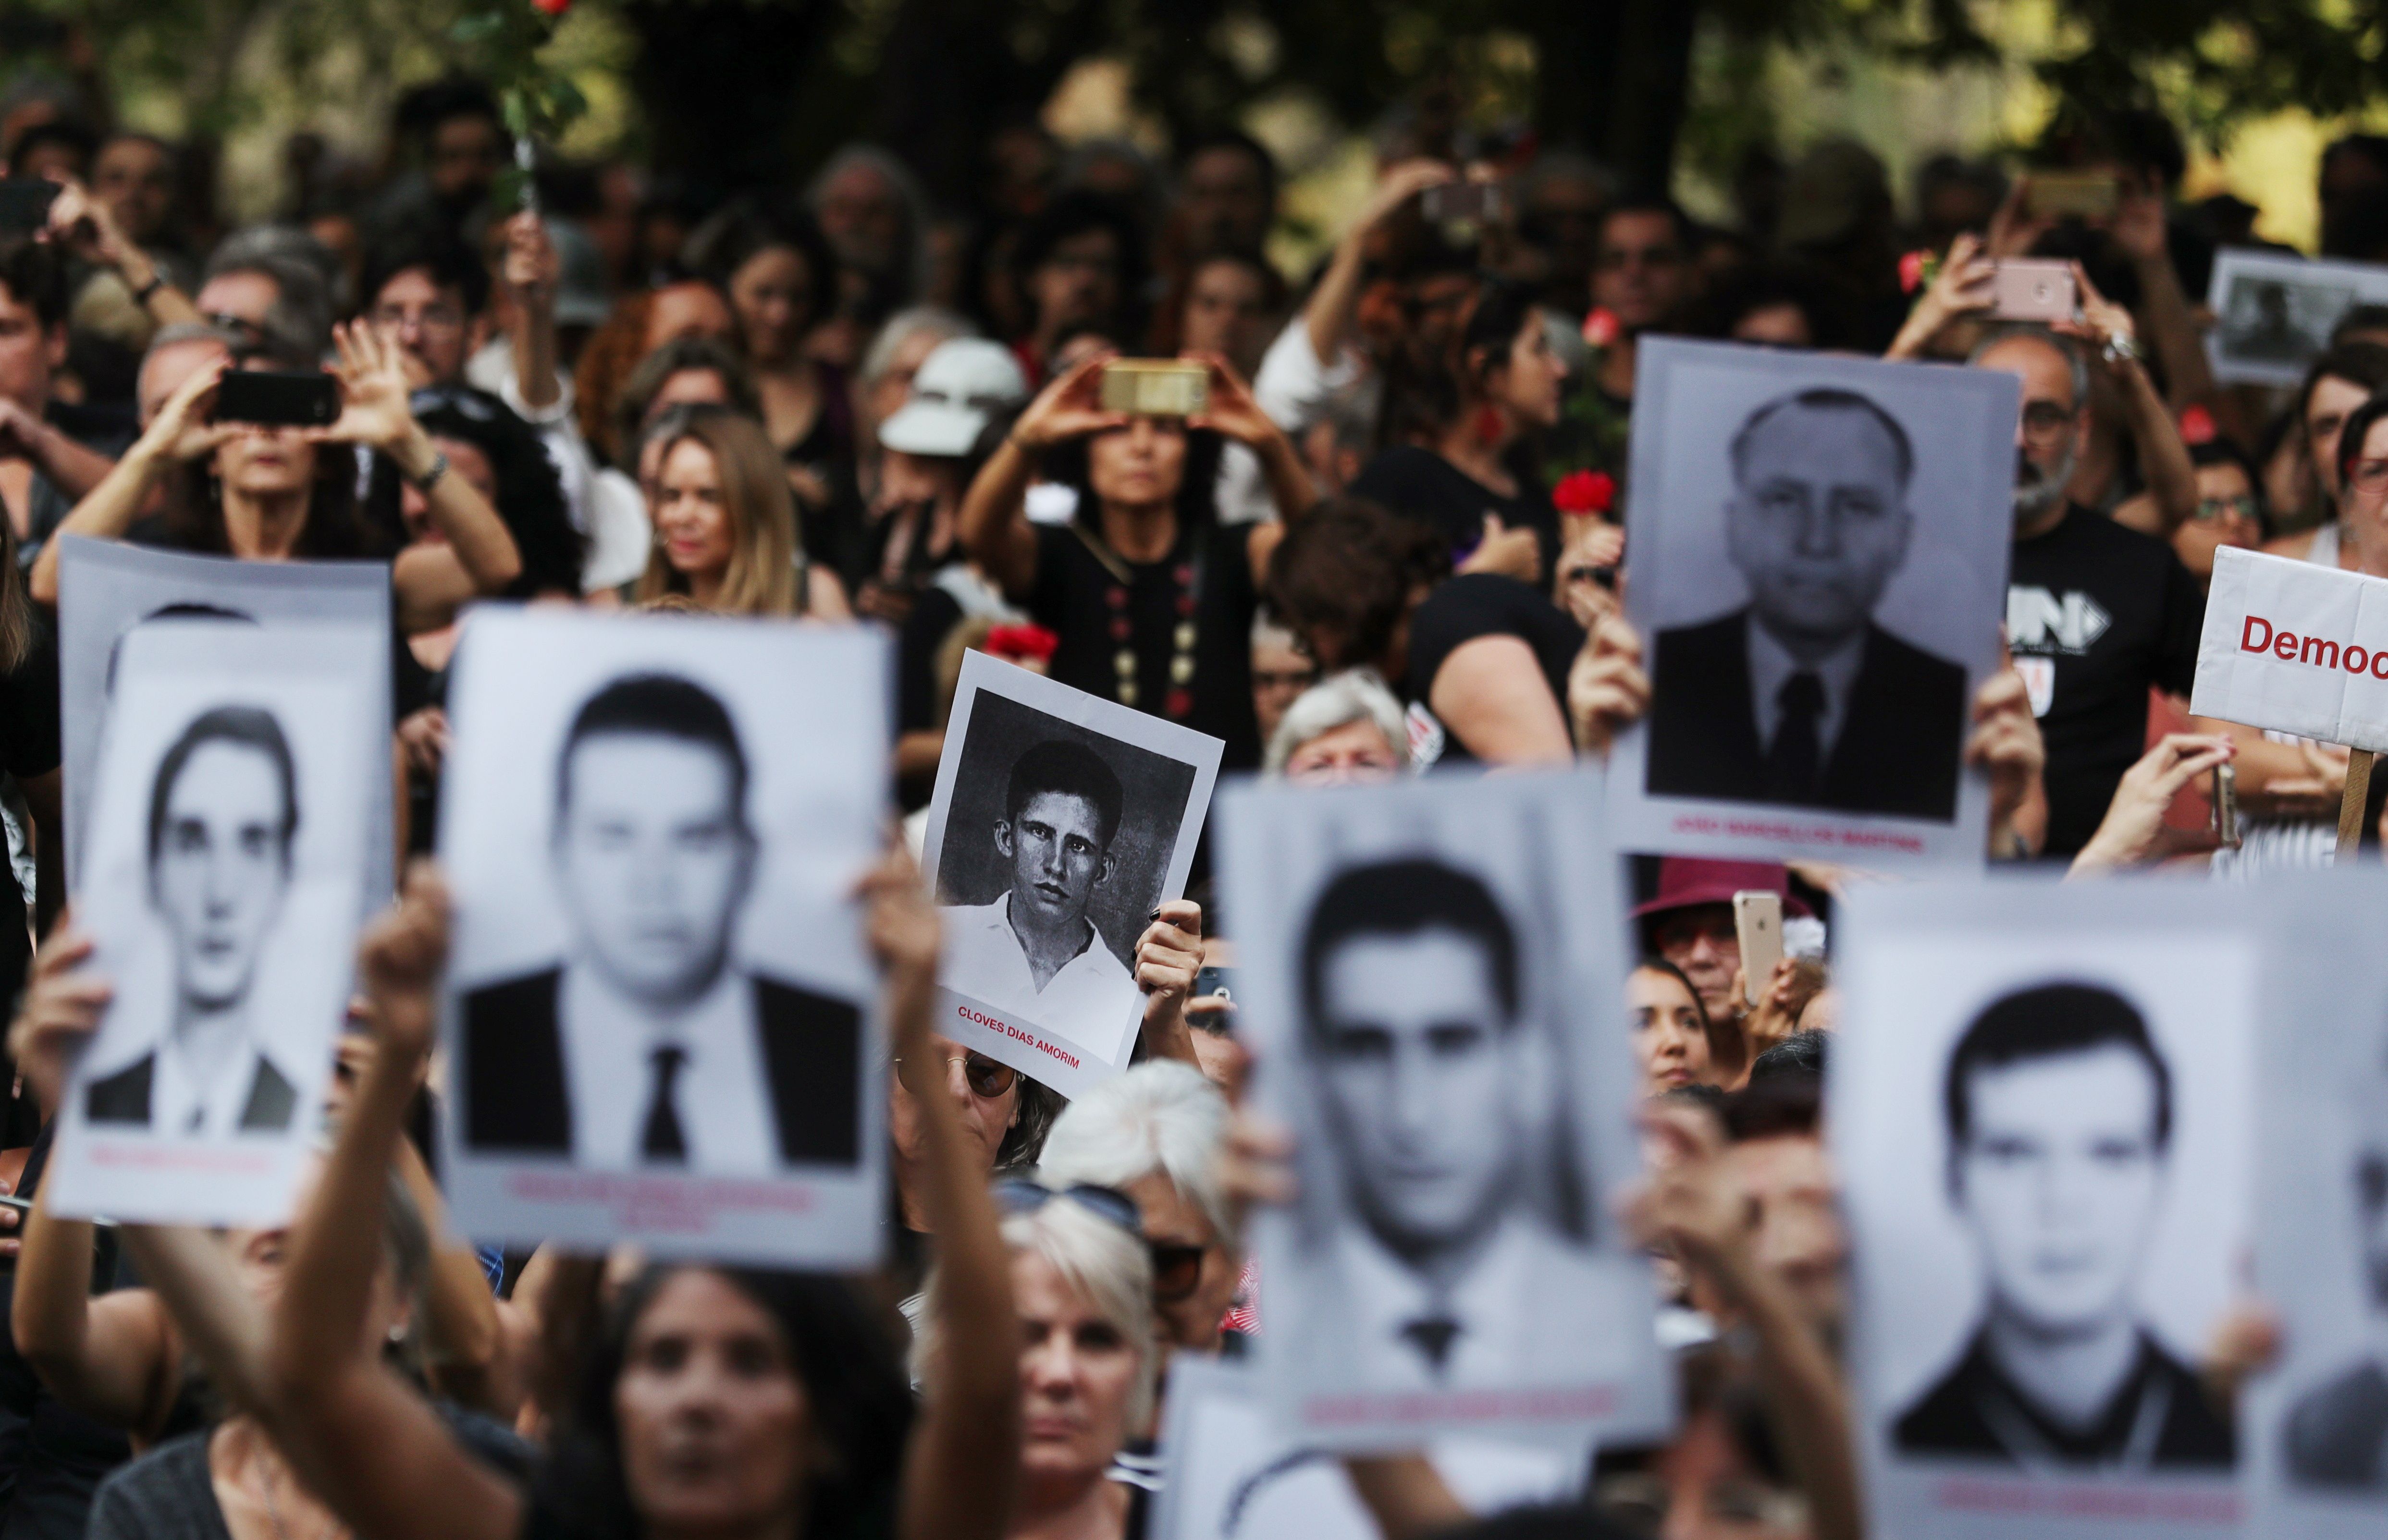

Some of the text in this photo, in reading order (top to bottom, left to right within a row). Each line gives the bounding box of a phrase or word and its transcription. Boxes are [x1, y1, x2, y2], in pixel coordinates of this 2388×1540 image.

[2241, 615, 2388, 680] Democ
[958, 1006, 1080, 1069] CLOVES DIAS AMORIM
